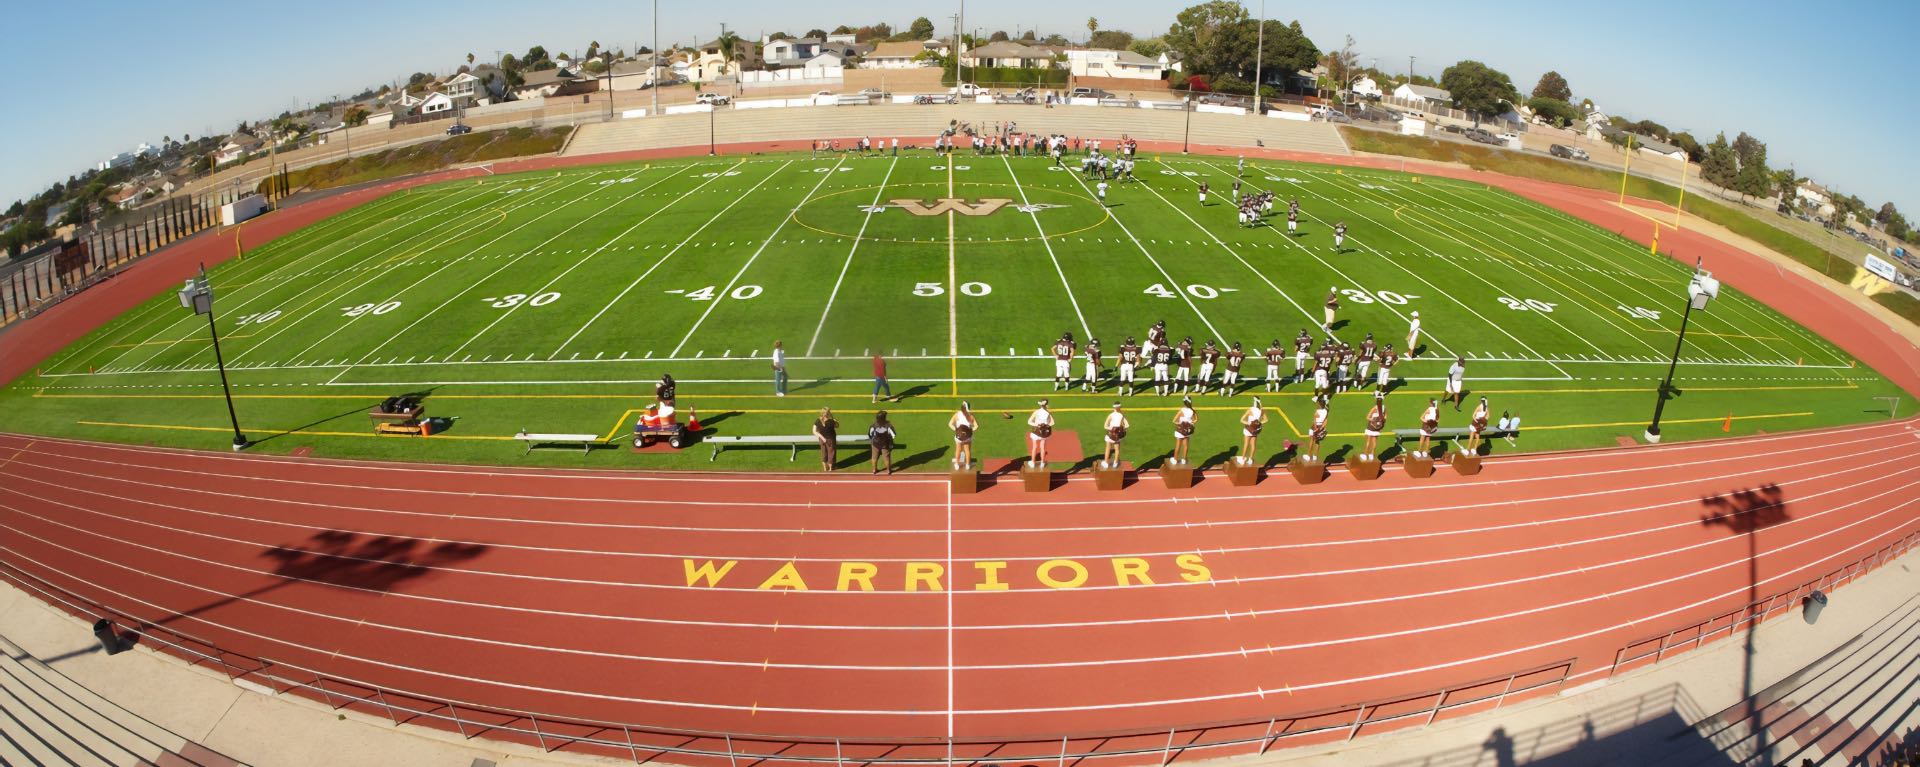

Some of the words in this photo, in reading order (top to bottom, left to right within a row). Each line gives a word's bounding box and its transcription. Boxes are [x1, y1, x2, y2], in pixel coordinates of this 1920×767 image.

[889, 198, 1013, 216] W
[912, 282, 992, 297] 50
[1851, 265, 1889, 296] W
[1385, 355, 1393, 366] 2
[683, 555, 1212, 592] WARRIORS
